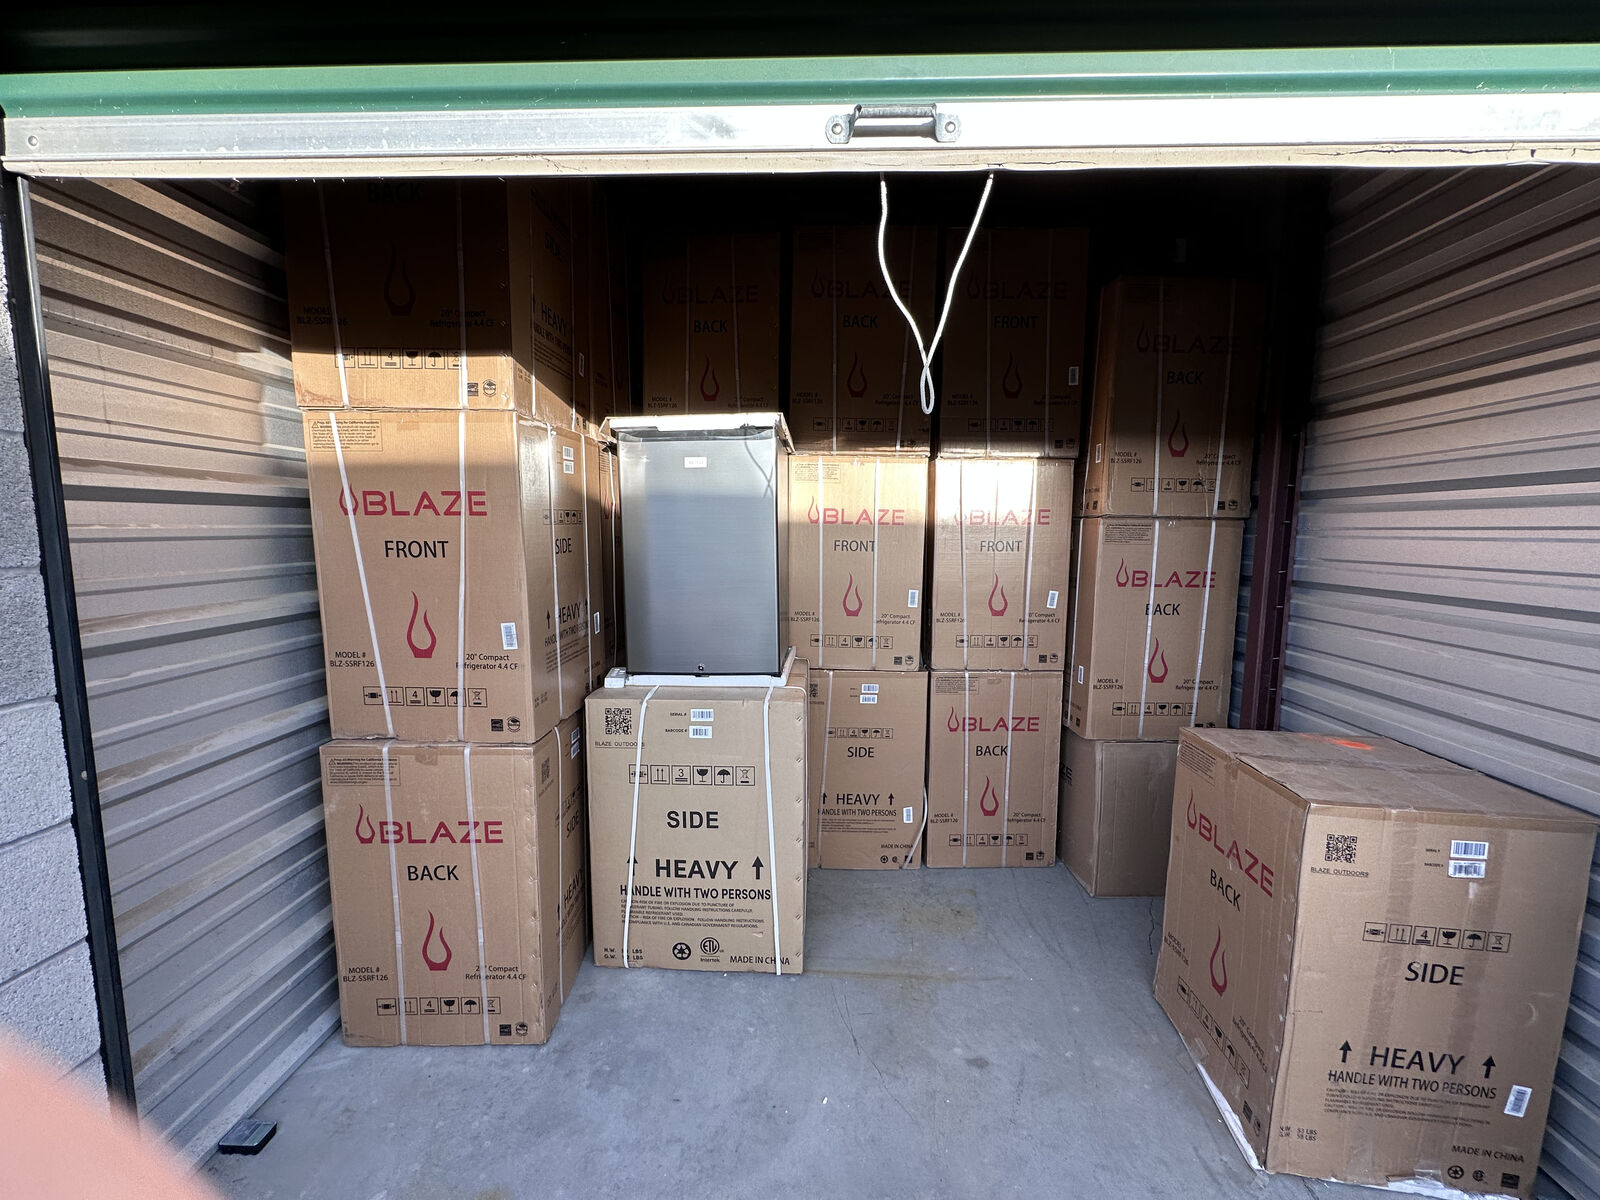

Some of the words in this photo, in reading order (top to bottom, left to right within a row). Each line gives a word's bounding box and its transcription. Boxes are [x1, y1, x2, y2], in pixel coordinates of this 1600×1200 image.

[677, 284, 760, 304] BLAZE
[984, 281, 1067, 300] BLAZE
[541, 302, 568, 338] HEAVY
[693, 319, 729, 334] BACK
[842, 314, 878, 329] BACK
[993, 315, 1038, 329] FRONT
[1167, 370, 1203, 385] BACK
[361, 490, 488, 516] BLAZE
[823, 507, 905, 525] BLAZE
[969, 508, 1051, 526] BLAZE
[384, 540, 449, 558] FRONT
[555, 537, 572, 555] SIDE
[833, 540, 876, 551] FRONT
[979, 540, 1022, 552] FRONT
[889, 613, 911, 621] Compact
[1034, 612, 1056, 620] Compact
[335, 651, 361, 659] MODEL
[478, 653, 510, 662] Compact
[330, 660, 375, 668] BLZ-SSRF126
[962, 716, 1040, 732] BLAZE
[847, 746, 875, 758] SIDE
[975, 745, 1008, 757] BACK
[836, 793, 880, 806] HEAVY
[666, 810, 719, 828] SIDE
[841, 808, 857, 816] WITH
[857, 809, 871, 817] TWO
[871, 809, 897, 818] PERSONS
[379, 821, 504, 844] BLAZE
[566, 813, 580, 839] SIDE
[1199, 812, 1275, 898] BLAZE
[407, 865, 459, 881] BACK
[655, 858, 739, 880] HEAVY
[1310, 866, 1330, 874] BLAZE
[1332, 869, 1369, 878] OUTDOORS
[620, 884, 662, 898] HANDLE
[663, 886, 691, 898] WITH
[693, 887, 719, 899] TWO
[721, 888, 771, 900] PERSONS
[1210, 868, 1241, 912] BACK
[730, 956, 753, 964] MADE
[755, 956, 763, 964] IN
[764, 957, 790, 966] CHNA
[465, 973, 505, 982] Refrierator
[488, 965, 519, 974] Compact
[1405, 961, 1465, 986] SIDE
[1370, 1045, 1465, 1075] HEAVY
[1328, 1069, 1375, 1085] HANDLE
[1378, 1073, 1408, 1089] WITH
[1411, 1078, 1439, 1092] TWO
[1442, 1081, 1497, 1099] PERSONS
[1452, 1144, 1480, 1158] MADE
[1481, 1149, 1492, 1159] IN
[1494, 1151, 1525, 1164] CHINA
